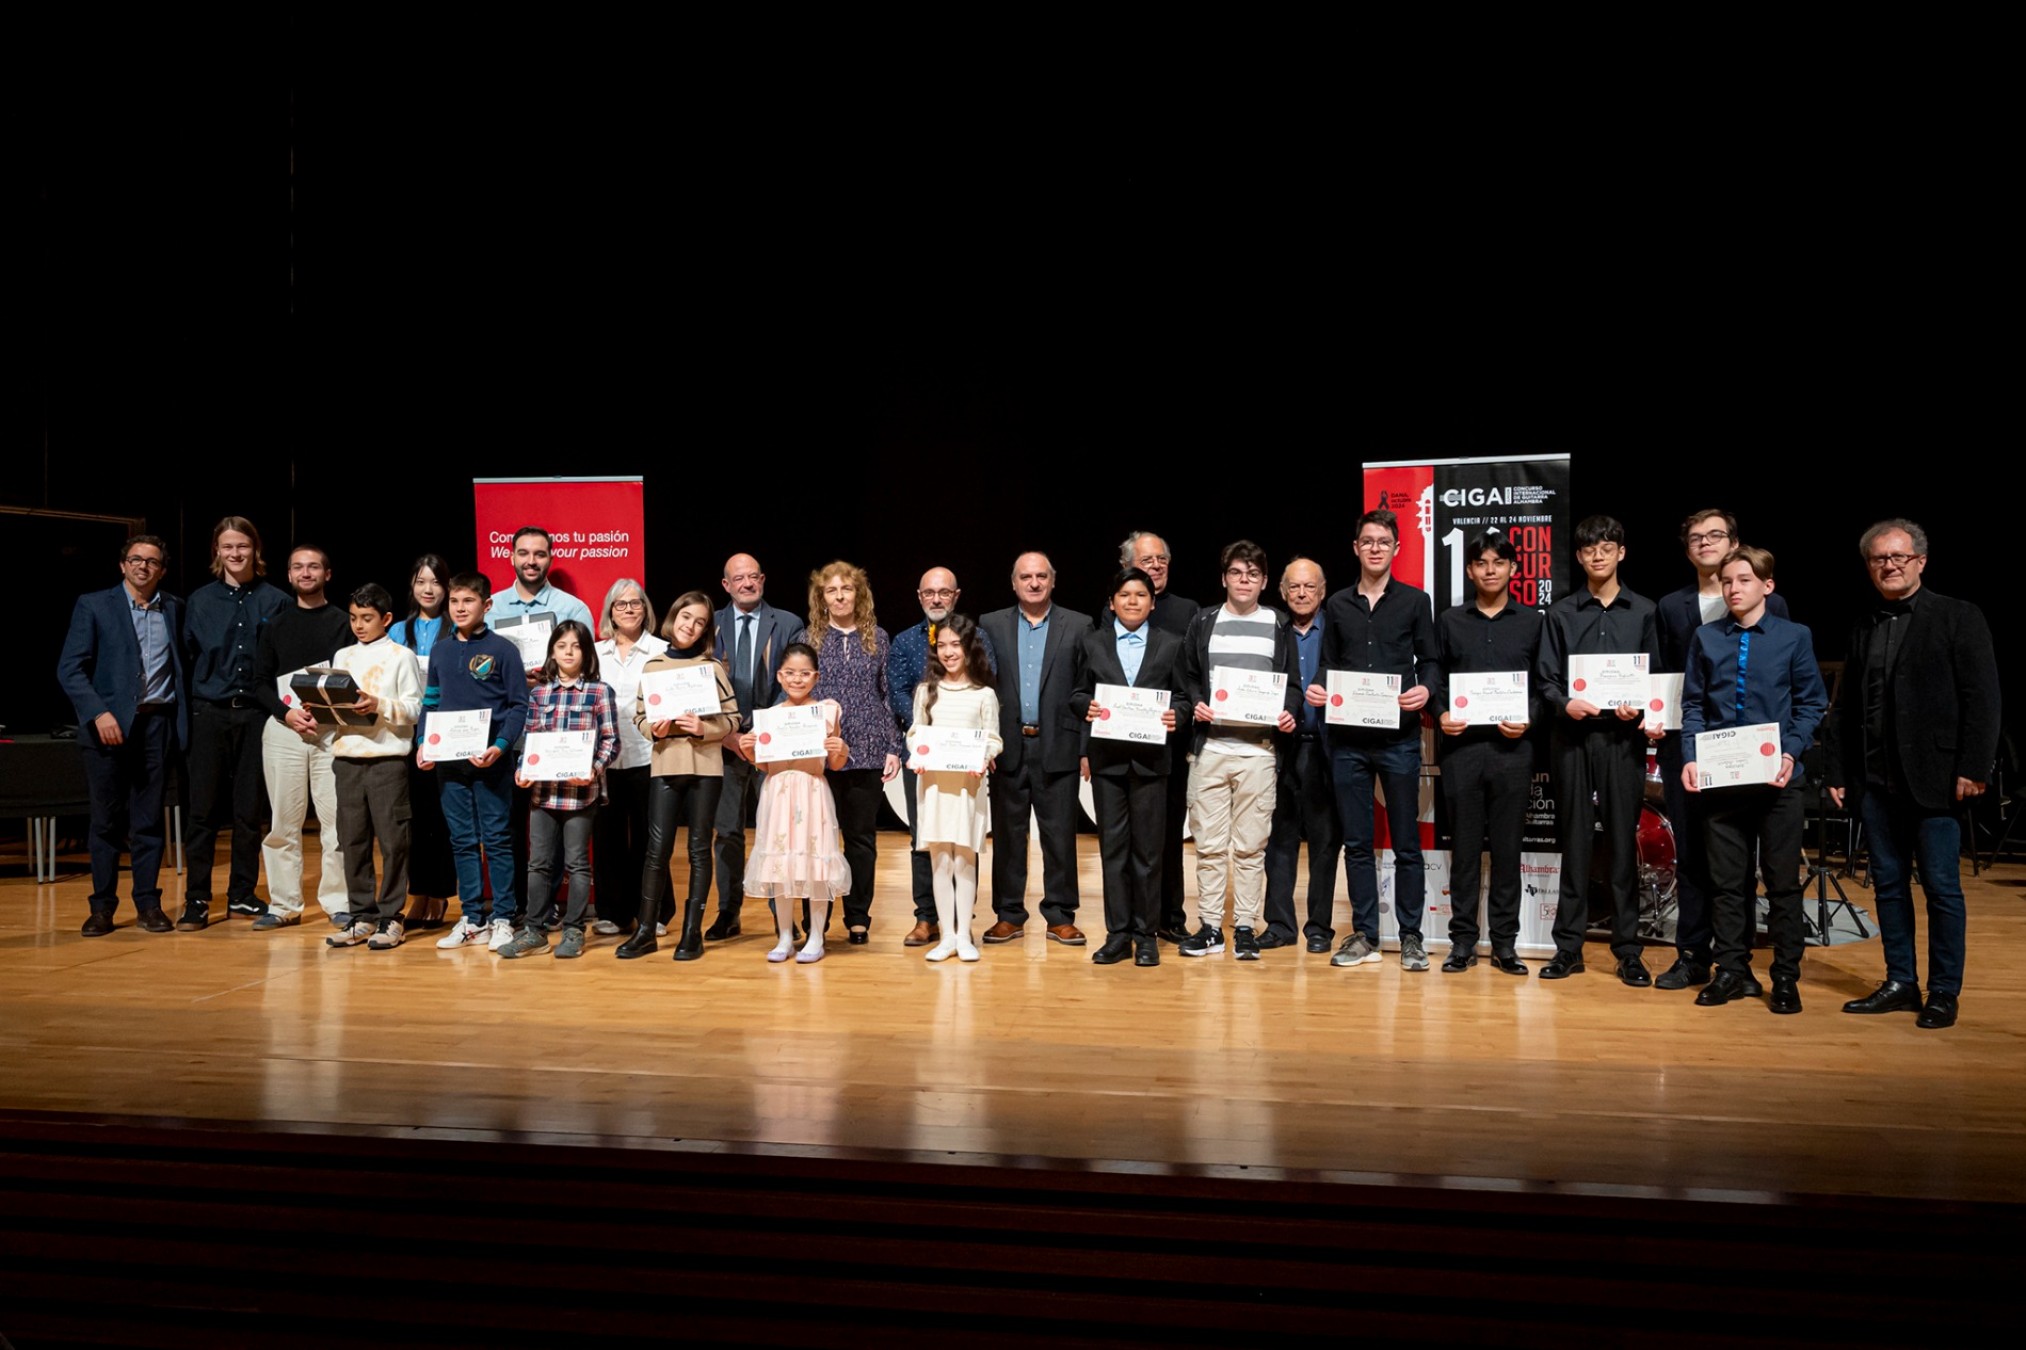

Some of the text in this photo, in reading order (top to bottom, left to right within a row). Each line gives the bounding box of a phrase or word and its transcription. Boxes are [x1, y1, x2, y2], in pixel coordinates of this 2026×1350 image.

[1452, 517, 1481, 525] VALENCIA
[1490, 516, 1498, 524] 22
[1518, 515, 1552, 523] NOVIEMBRE
[573, 531, 586, 542] tu
[589, 530, 629, 545] pasión
[1509, 526, 1551, 552] CON
[491, 546, 511, 558] We
[579, 545, 629, 560] passion
[1509, 579, 1537, 606] SO
[1538, 580, 1552, 593] 20
[1538, 592, 1552, 605] 24
